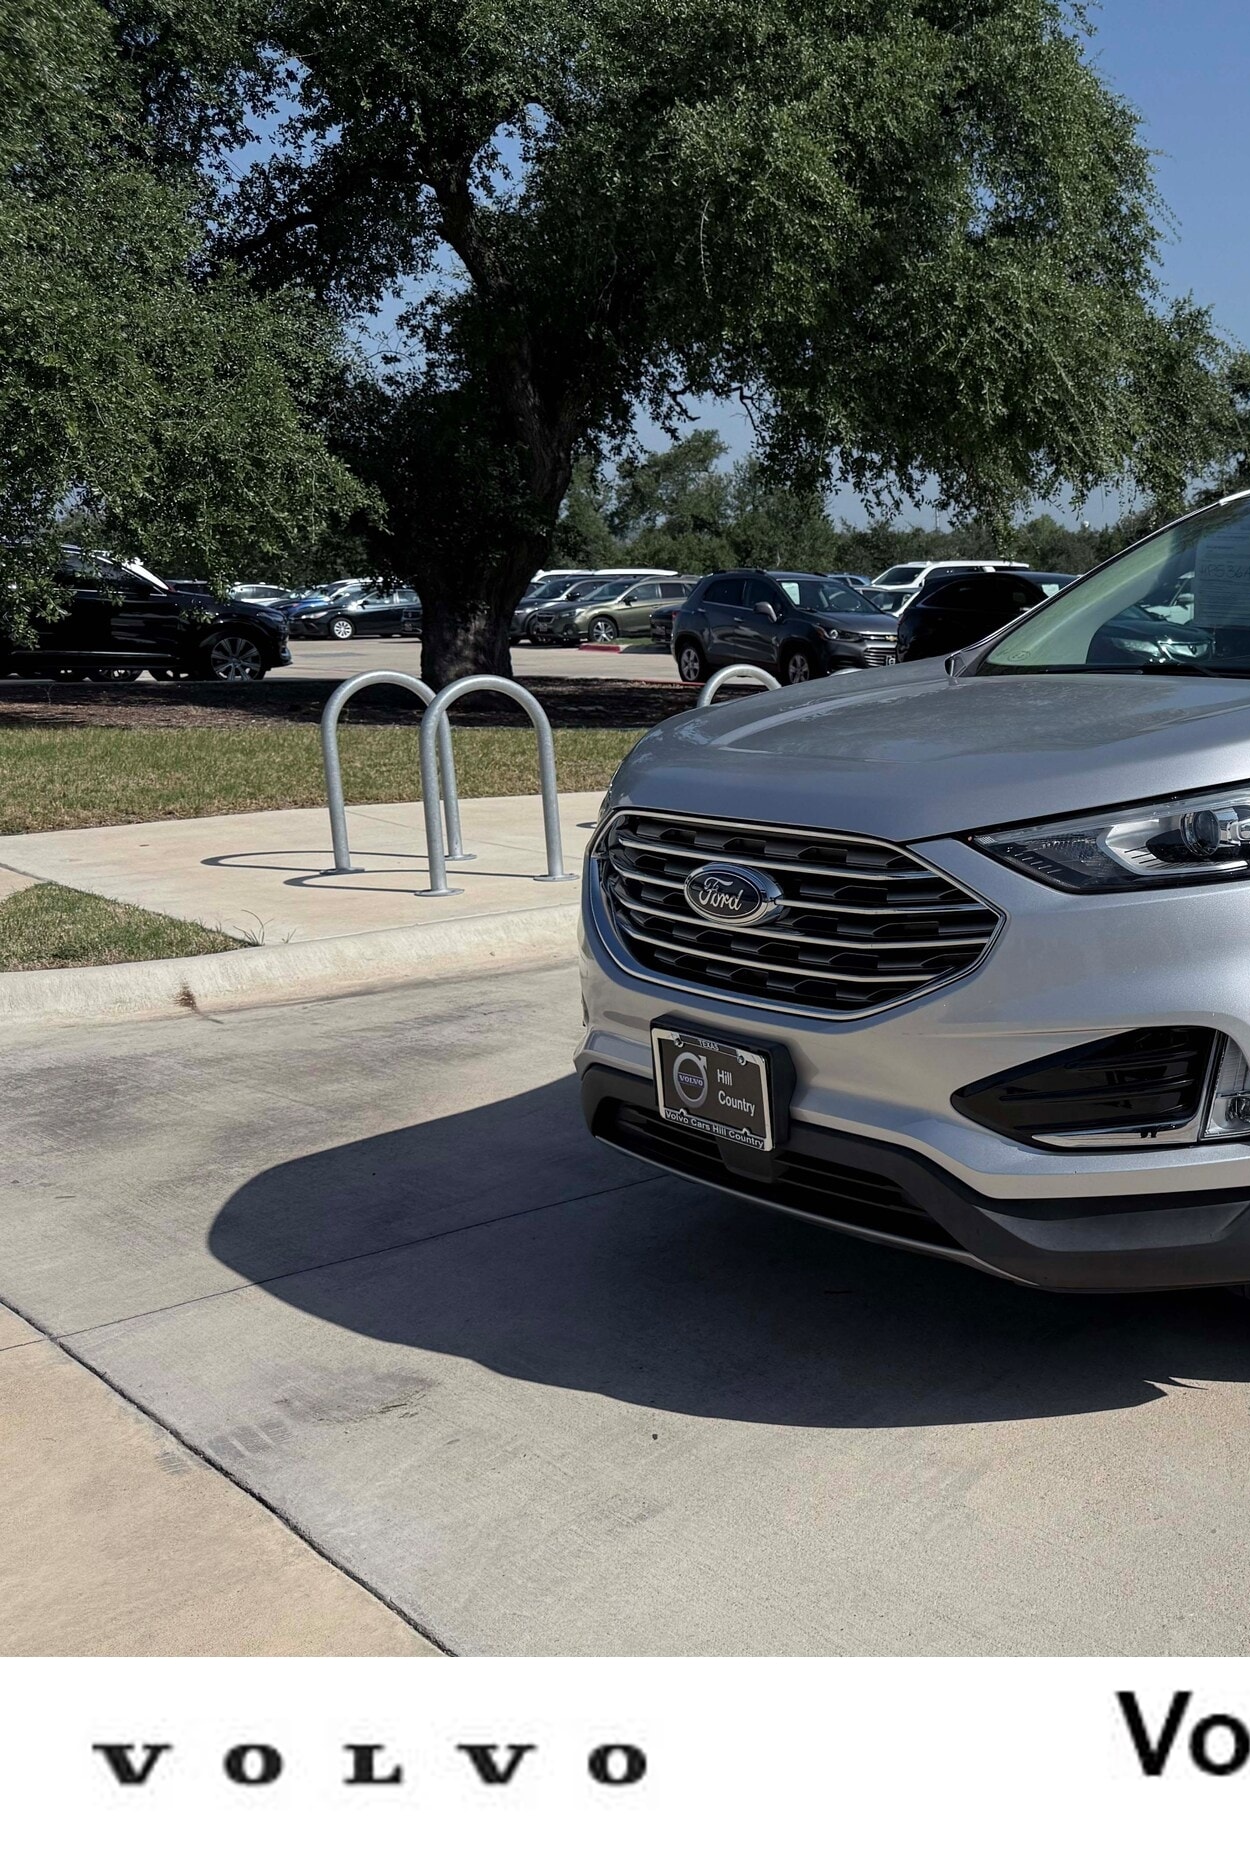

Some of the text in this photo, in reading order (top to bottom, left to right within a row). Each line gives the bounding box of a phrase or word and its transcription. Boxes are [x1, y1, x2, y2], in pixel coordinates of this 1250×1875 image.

[699, 877, 744, 911] Ford
[699, 1040, 719, 1051] TEXAS
[678, 1074, 704, 1087] VOLVO
[717, 1069, 733, 1086] Hill
[718, 1090, 756, 1117] Country
[665, 1110, 764, 1149] Volvo Cars Hill Country
